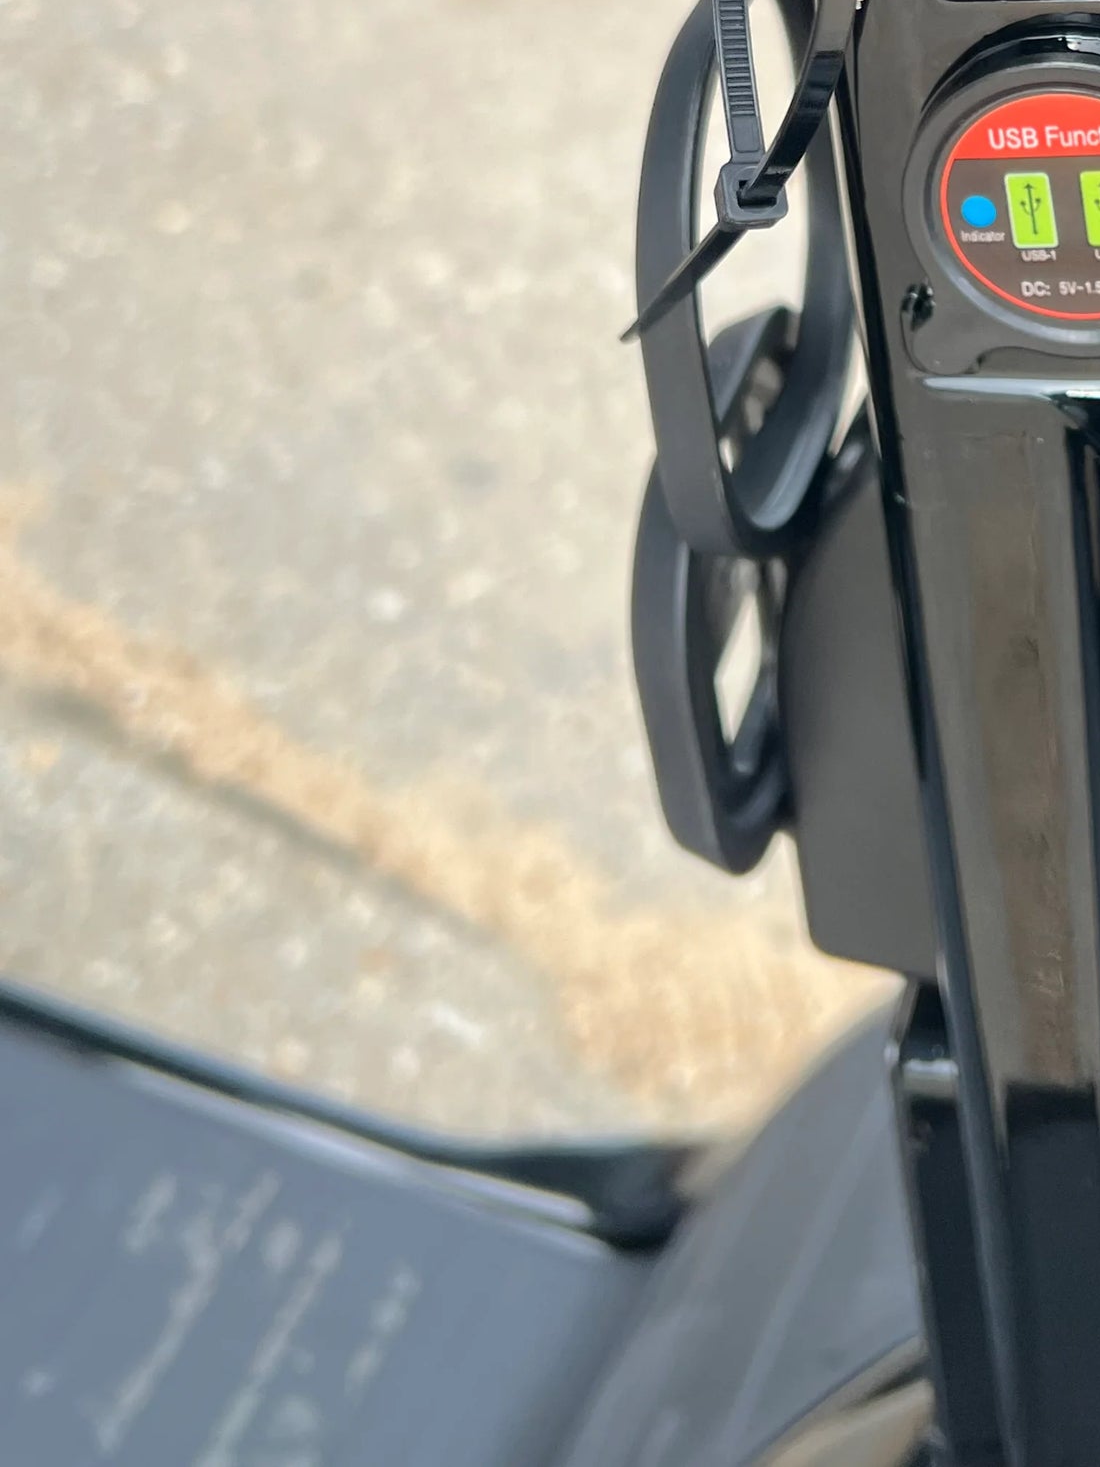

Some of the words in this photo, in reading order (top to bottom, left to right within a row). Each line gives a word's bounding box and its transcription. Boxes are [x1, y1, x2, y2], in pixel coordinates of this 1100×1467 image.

[988, 128, 1038, 150] USB
[961, 230, 1005, 242] Indicator
[1021, 250, 1057, 262] USB-1
[1020, 281, 1051, 297] DC:
